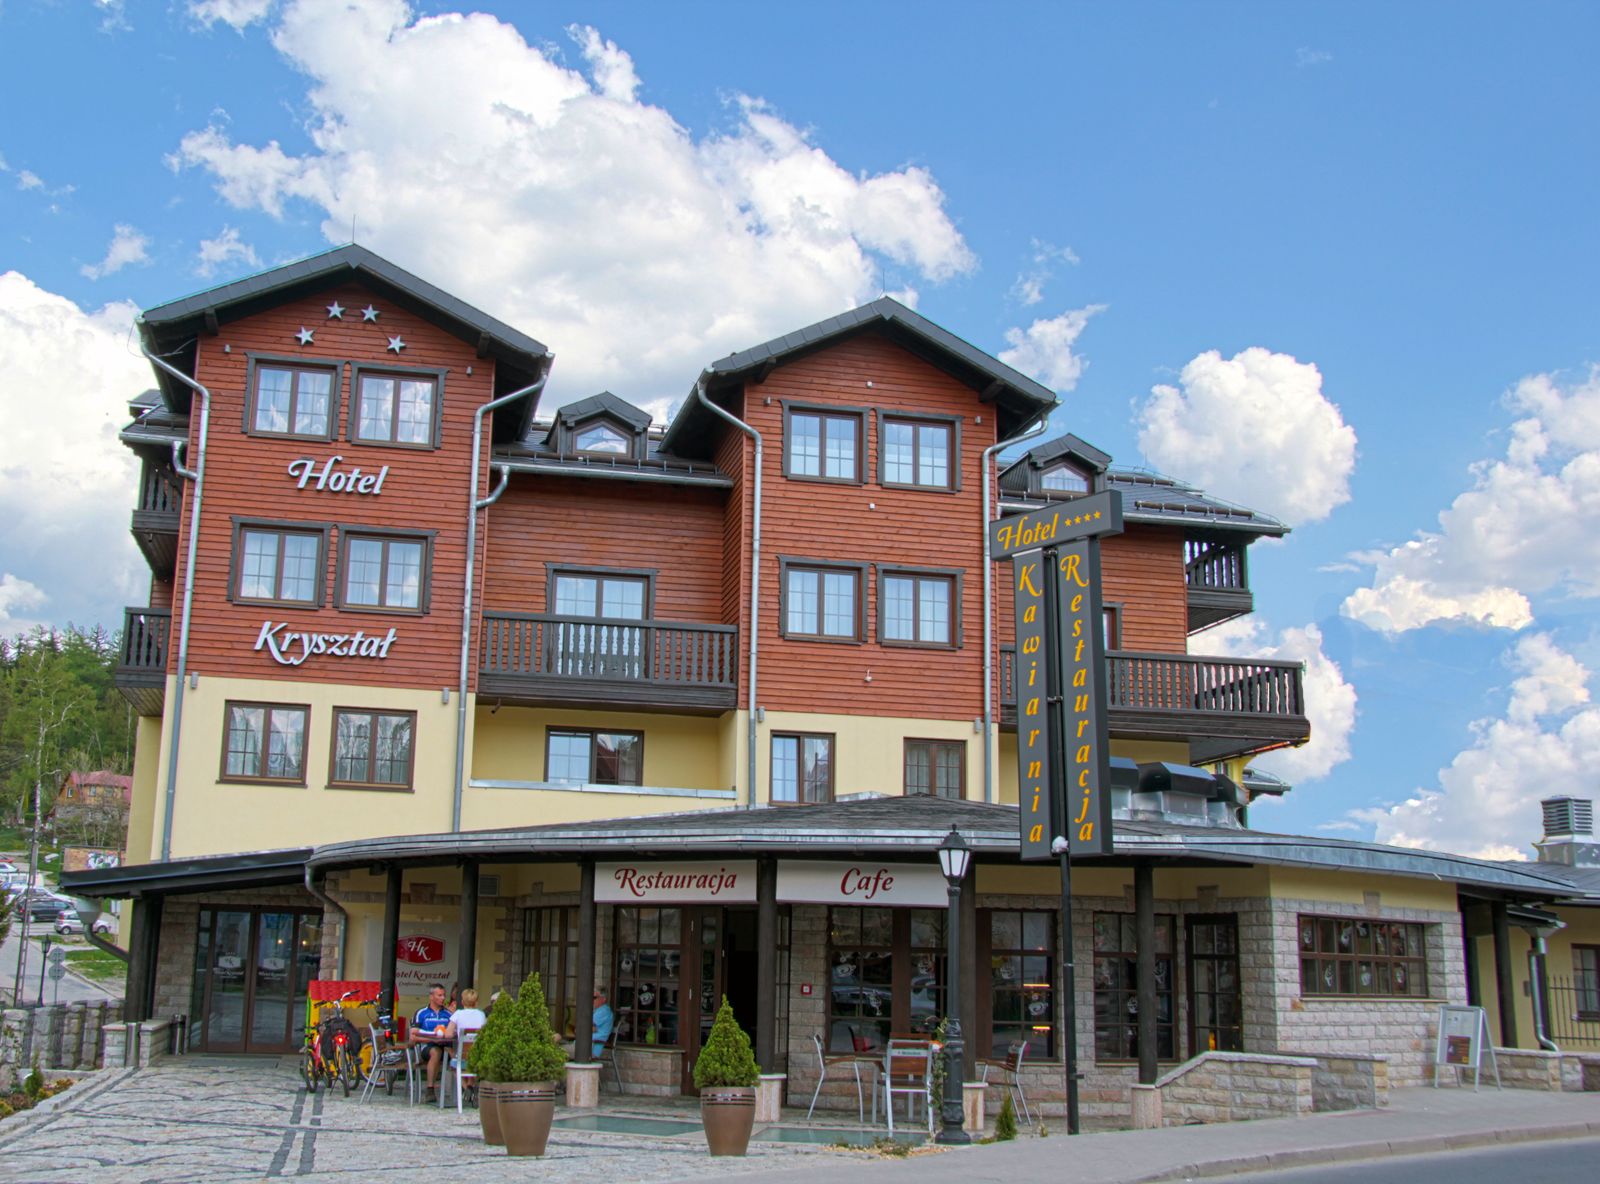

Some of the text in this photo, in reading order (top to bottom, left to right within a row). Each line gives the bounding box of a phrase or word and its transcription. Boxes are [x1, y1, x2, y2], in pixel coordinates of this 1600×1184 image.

[288, 456, 390, 495] Hotel
[997, 512, 1059, 551] Hotel
[254, 621, 397, 666] Kryształ
[1018, 563, 1043, 843] Kawiarnia
[1060, 554, 1094, 842] Restauracja
[614, 867, 737, 897] Restauracja
[840, 867, 894, 899] Cafe
